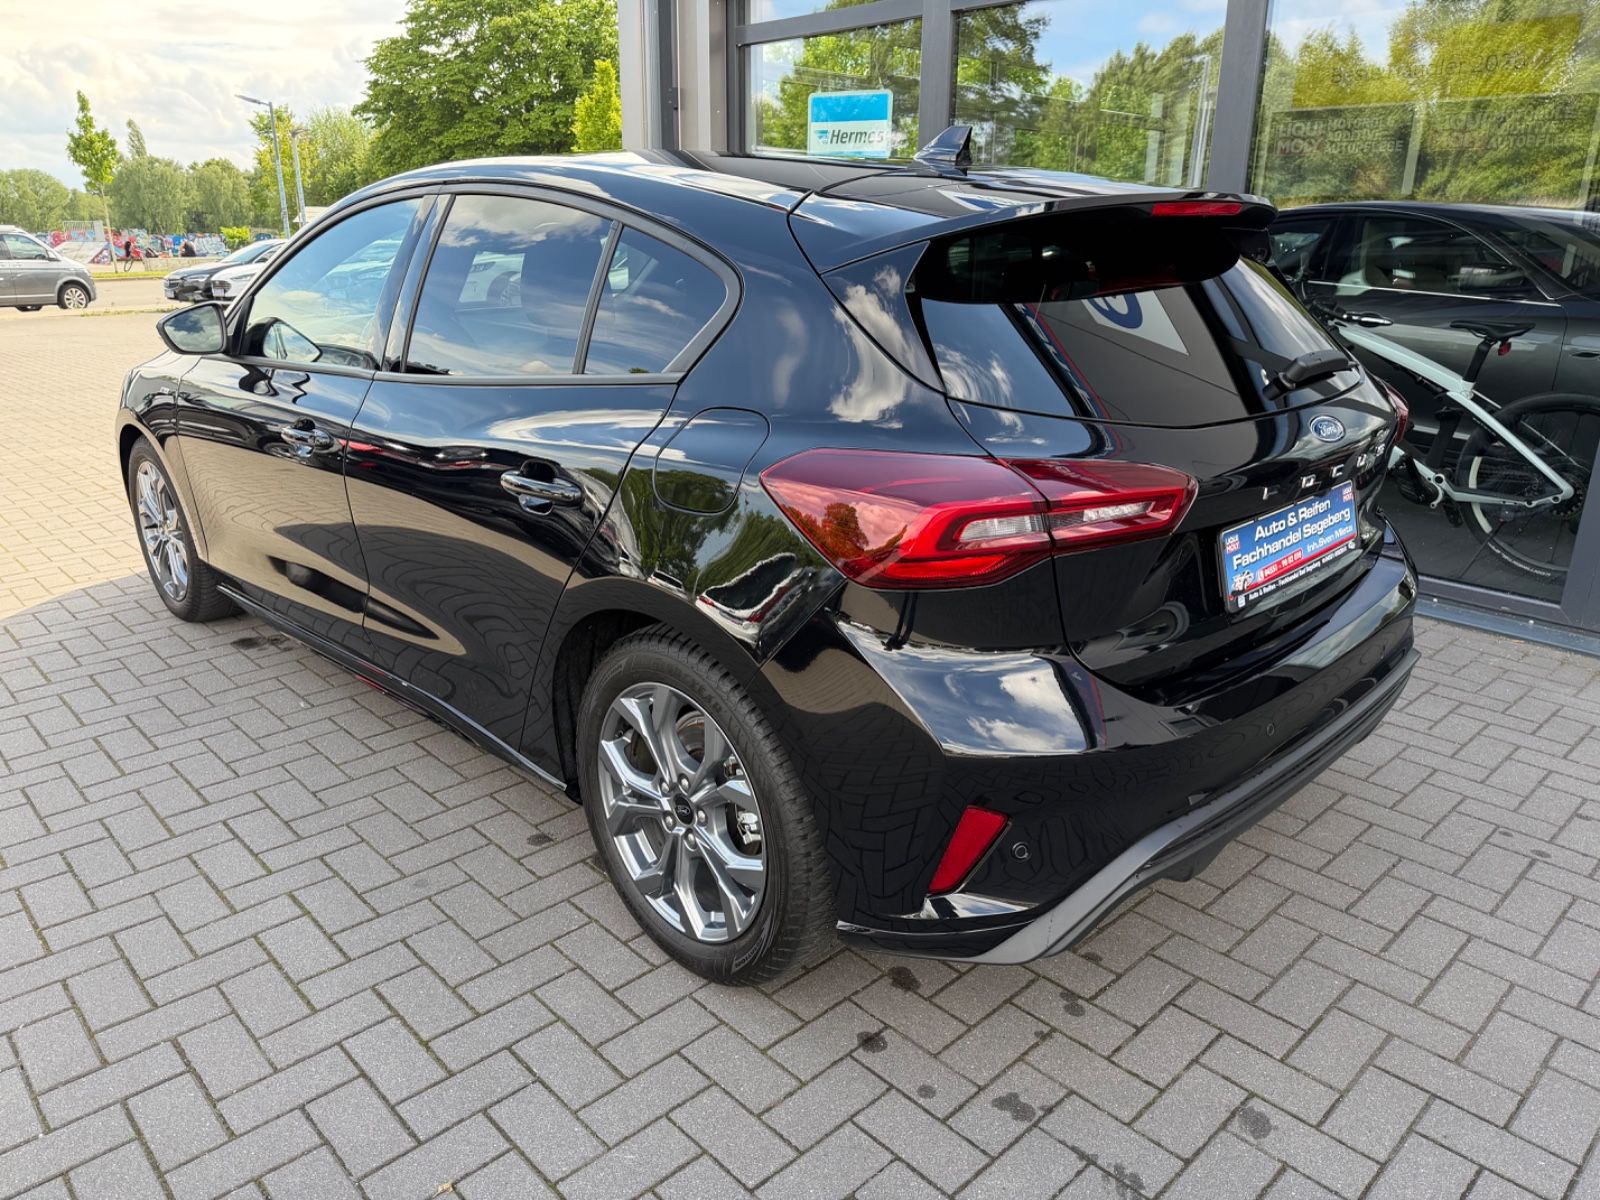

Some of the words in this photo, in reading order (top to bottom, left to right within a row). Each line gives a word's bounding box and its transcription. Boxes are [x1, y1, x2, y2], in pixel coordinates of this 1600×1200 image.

[830, 129, 885, 145] Hermes
[1232, 528, 1302, 570] Fachhandel
[1303, 508, 1351, 539] Segeberg
[1255, 520, 1286, 541] Auto
[1287, 512, 1297, 527] &
[1298, 500, 1331, 522] Reifen
